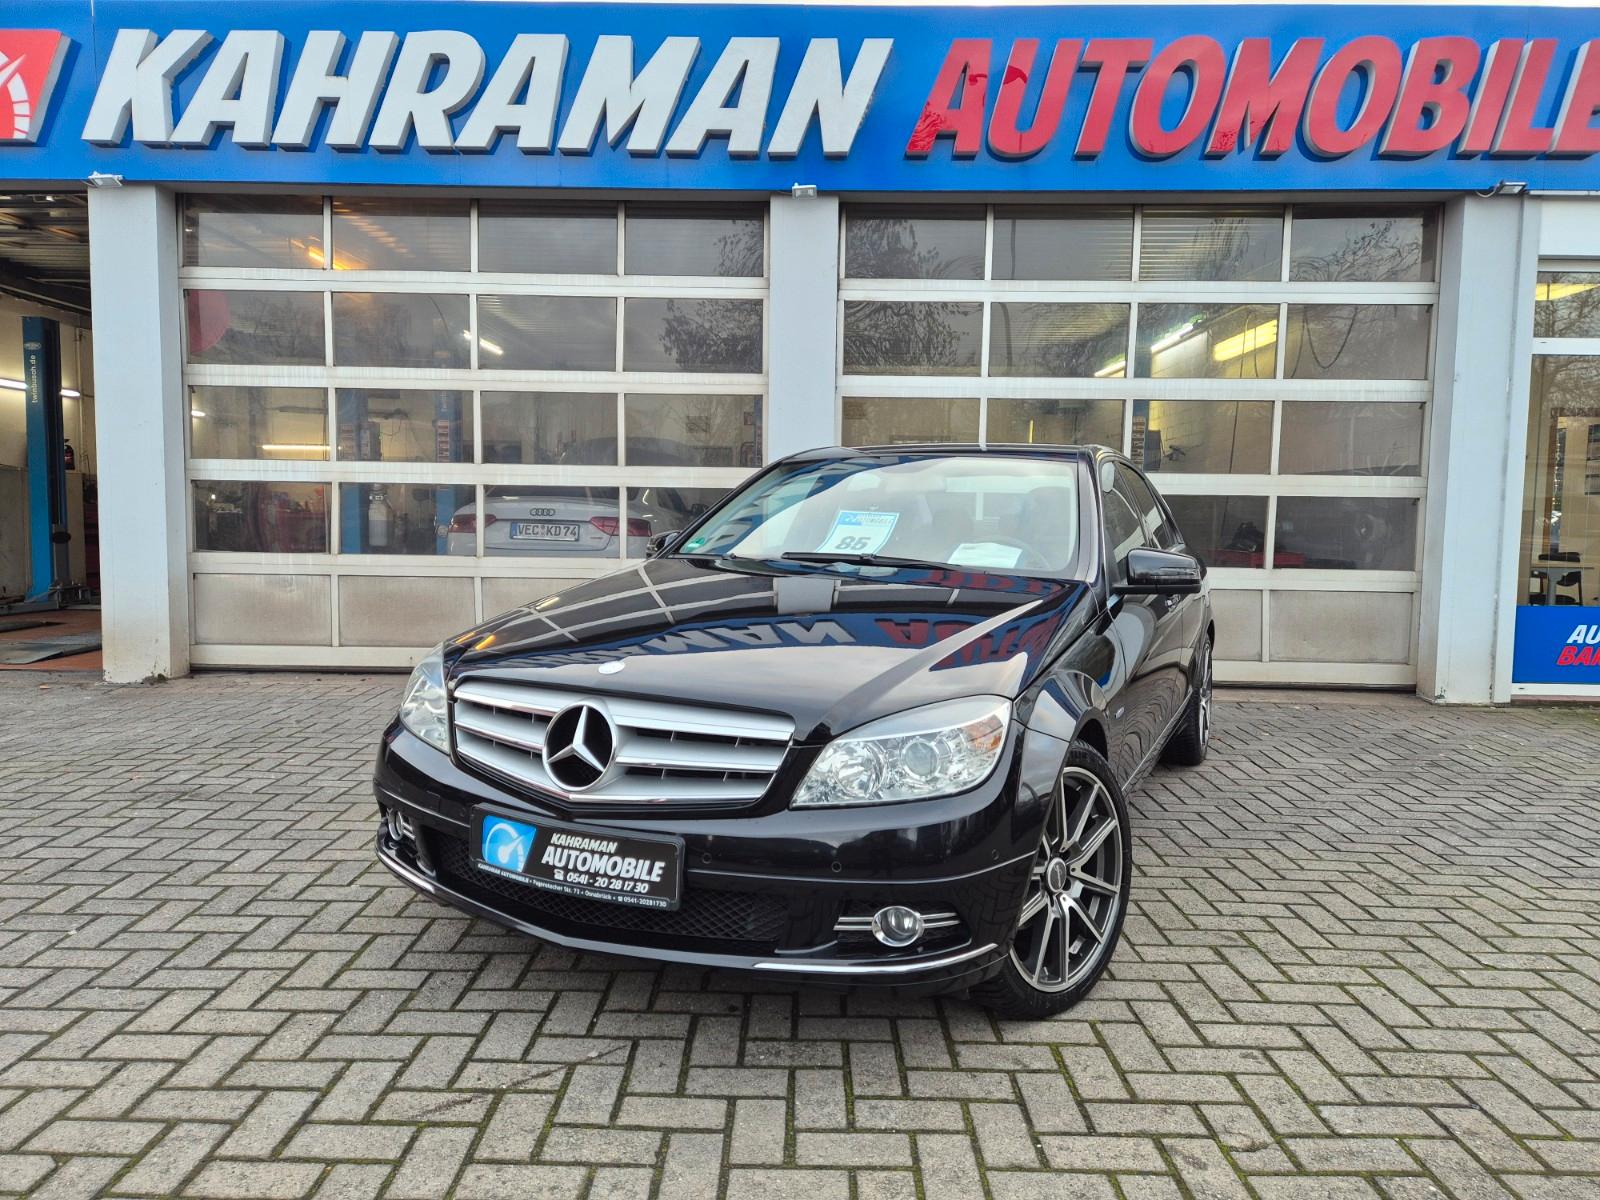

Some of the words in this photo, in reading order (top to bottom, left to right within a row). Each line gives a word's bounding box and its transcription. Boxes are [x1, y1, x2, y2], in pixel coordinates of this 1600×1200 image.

[81, 28, 895, 157] KAHRAMAN
[903, 36, 1600, 159] AUTOMOBILE
[518, 524, 539, 535] VEC
[546, 526, 561, 536] KD
[563, 526, 577, 537] 74
[835, 535, 871, 550] 85
[550, 832, 618, 854] KAHRAMAN
[541, 845, 666, 882] AUTOMOBILE
[566, 872, 589, 885] 0541
[594, 877, 608, 888] 20
[609, 879, 622, 890] 28
[623, 881, 635, 892] 17
[633, 883, 649, 893] 30
